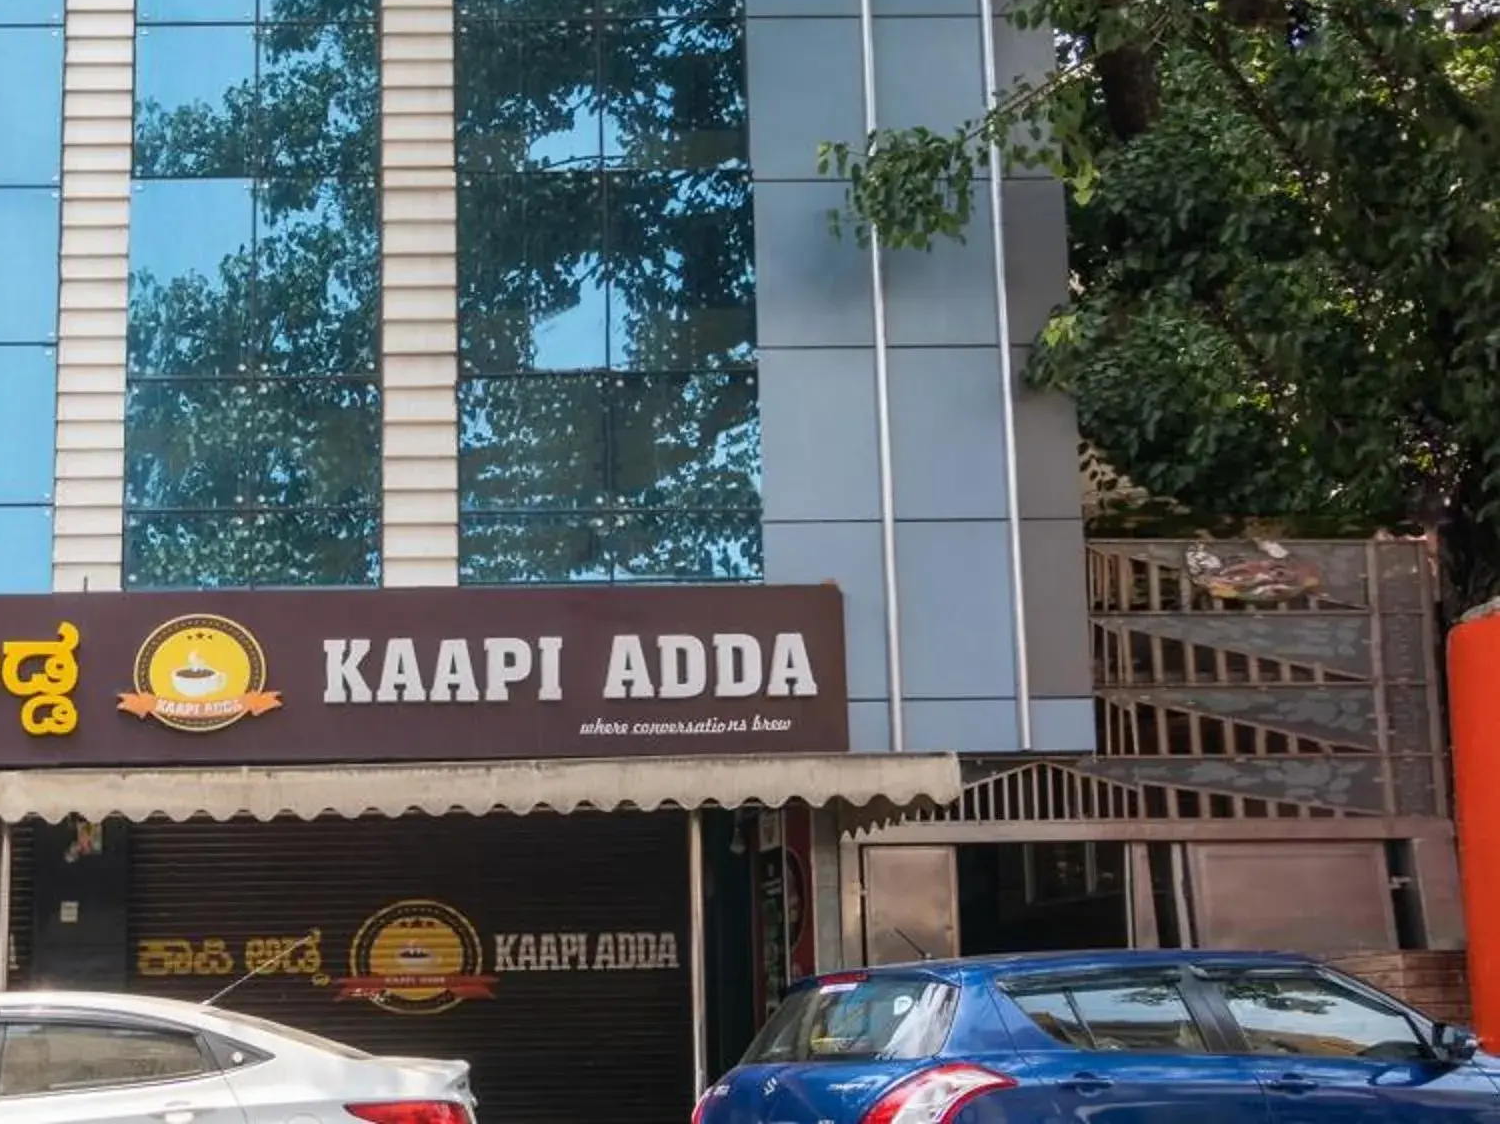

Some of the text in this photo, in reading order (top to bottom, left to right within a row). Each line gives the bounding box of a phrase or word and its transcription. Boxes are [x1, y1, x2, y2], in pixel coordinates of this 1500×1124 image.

[323, 632, 819, 704] KAAPI ADDA
[579, 717, 628, 735] where
[751, 713, 793, 732] brew
[494, 931, 680, 972] KAAPI ADDA
